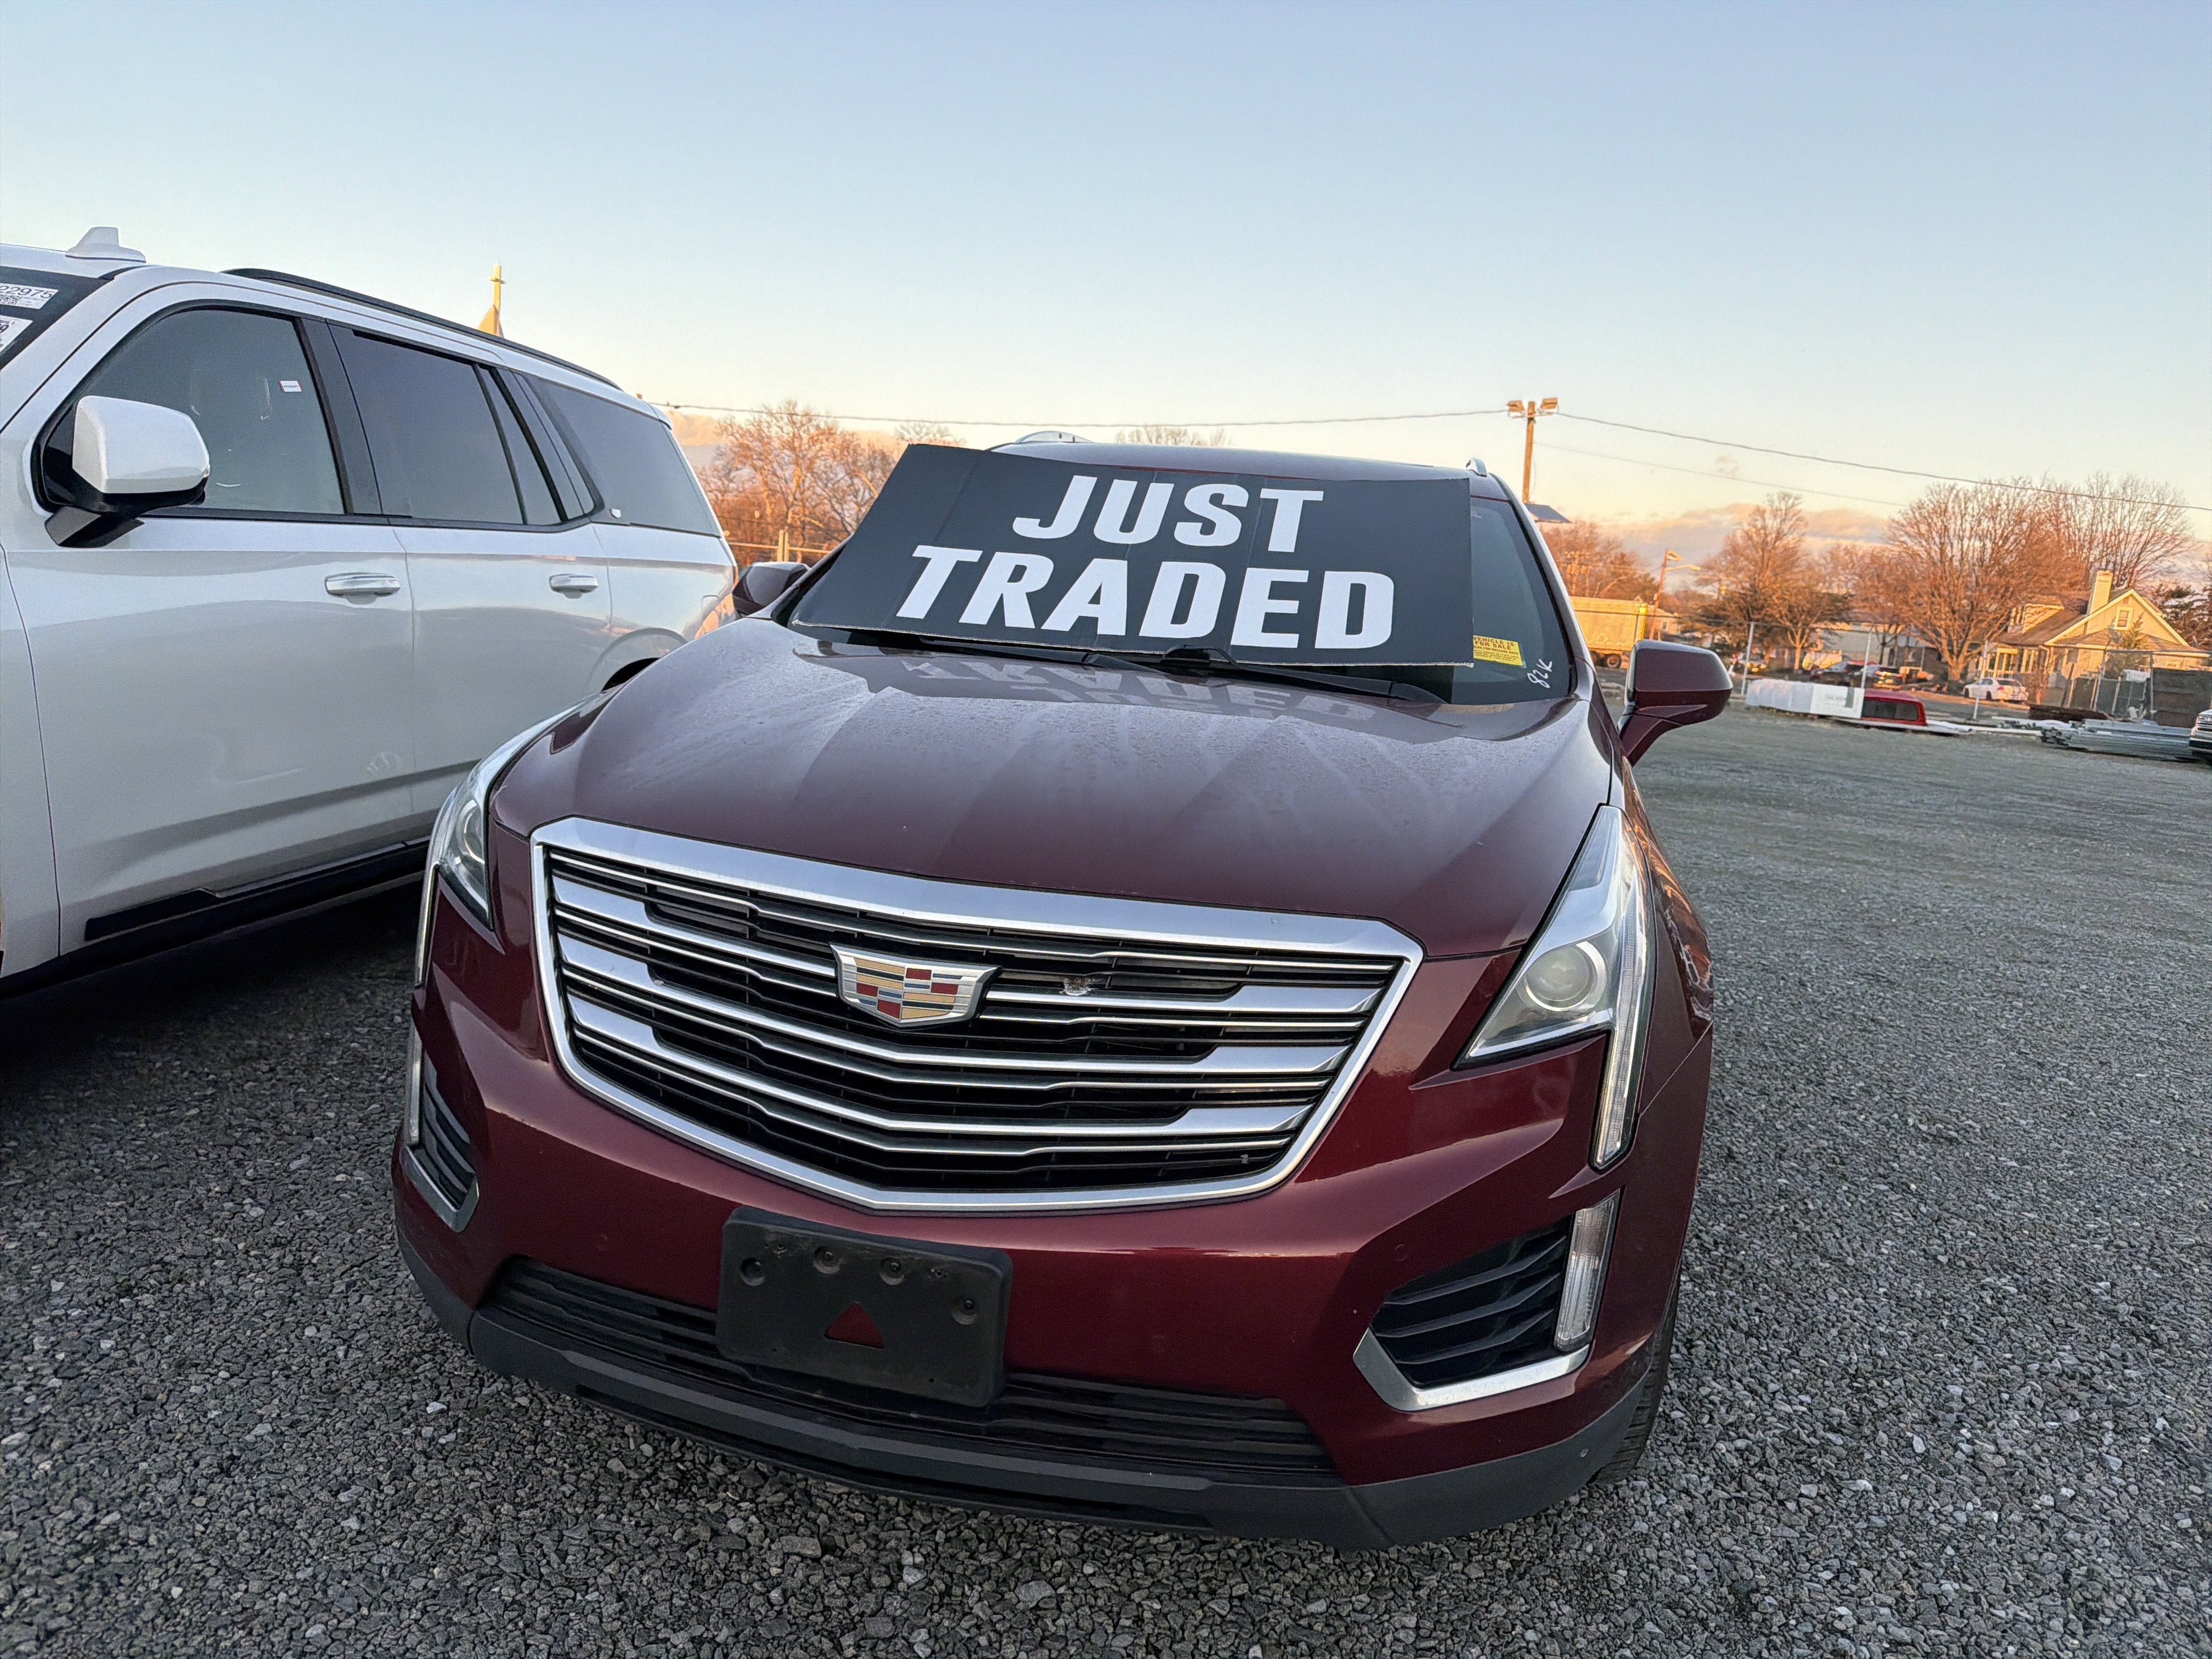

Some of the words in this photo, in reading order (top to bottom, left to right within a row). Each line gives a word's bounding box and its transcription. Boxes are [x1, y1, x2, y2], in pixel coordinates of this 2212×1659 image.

[0, 285, 55, 298] 22975
[1013, 476, 1323, 552] JUST
[896, 545, 1393, 648] TRADED
[1474, 636, 1504, 645] VEHICLE
[1527, 658, 1553, 689] 82K
